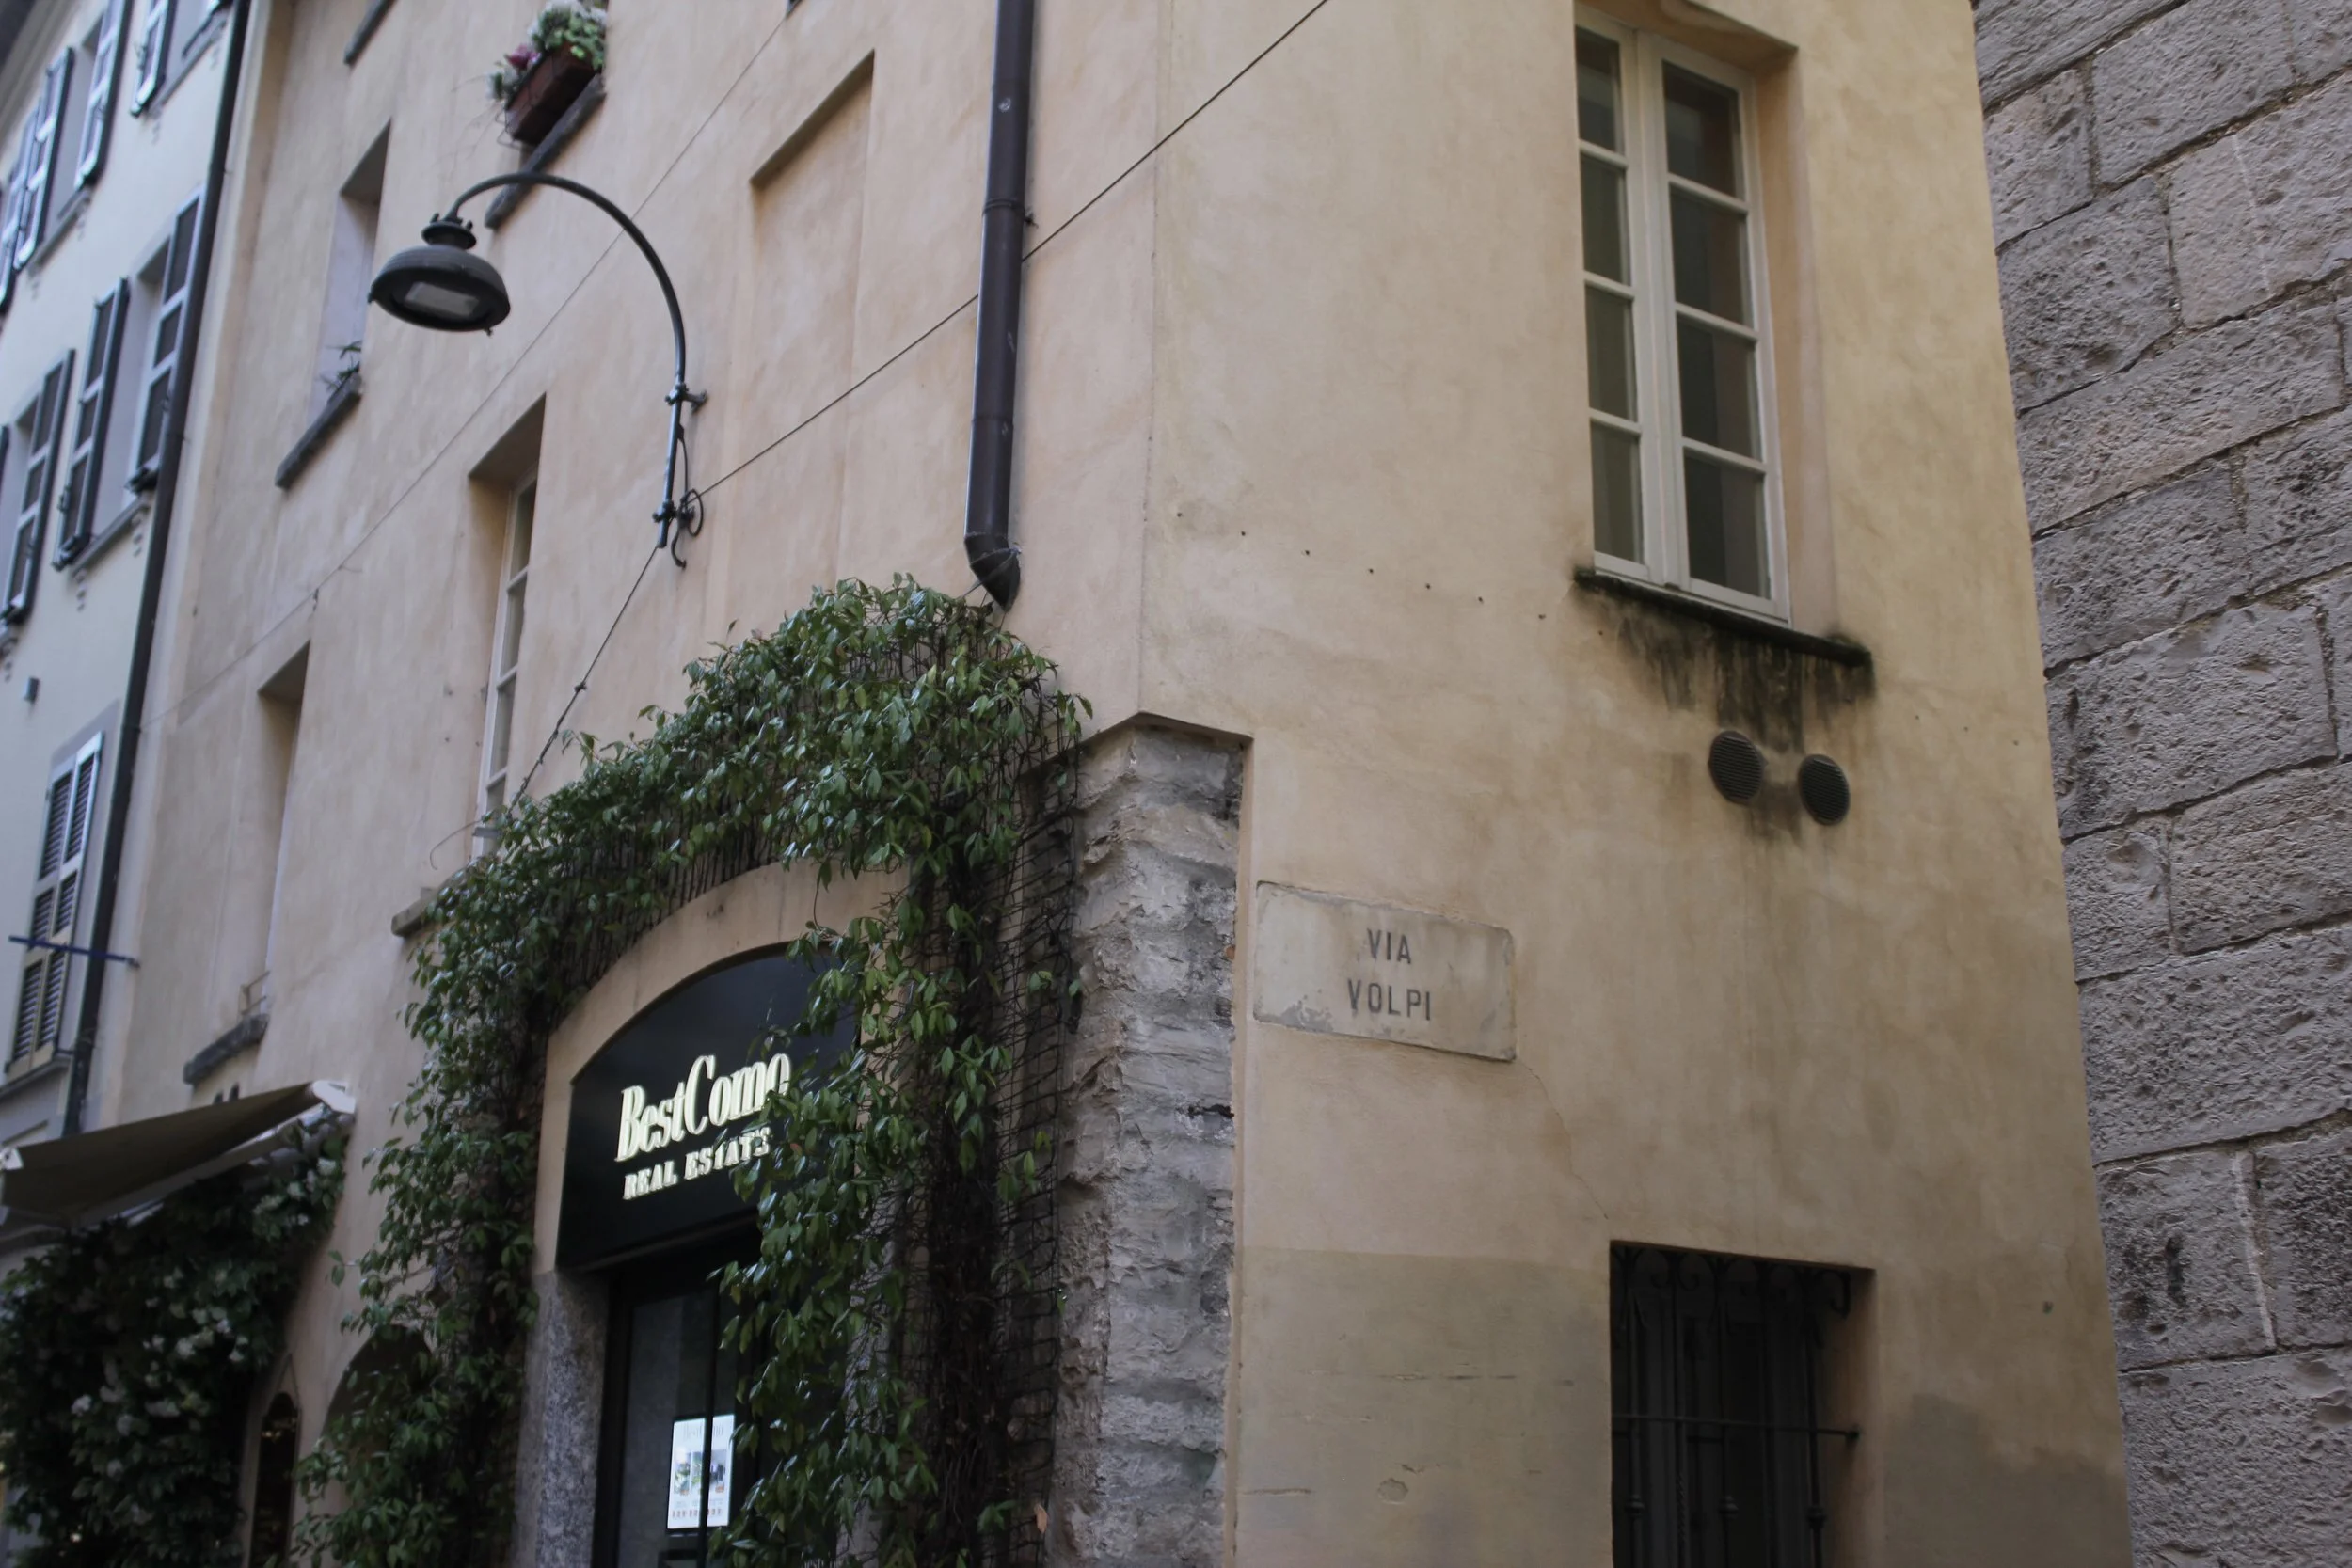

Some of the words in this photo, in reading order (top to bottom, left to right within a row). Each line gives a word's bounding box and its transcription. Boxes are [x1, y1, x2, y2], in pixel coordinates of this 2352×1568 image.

[1366, 927, 1411, 964] VIA
[1347, 977, 1431, 1021] VOLPI
[623, 1160, 678, 1200] REAL
